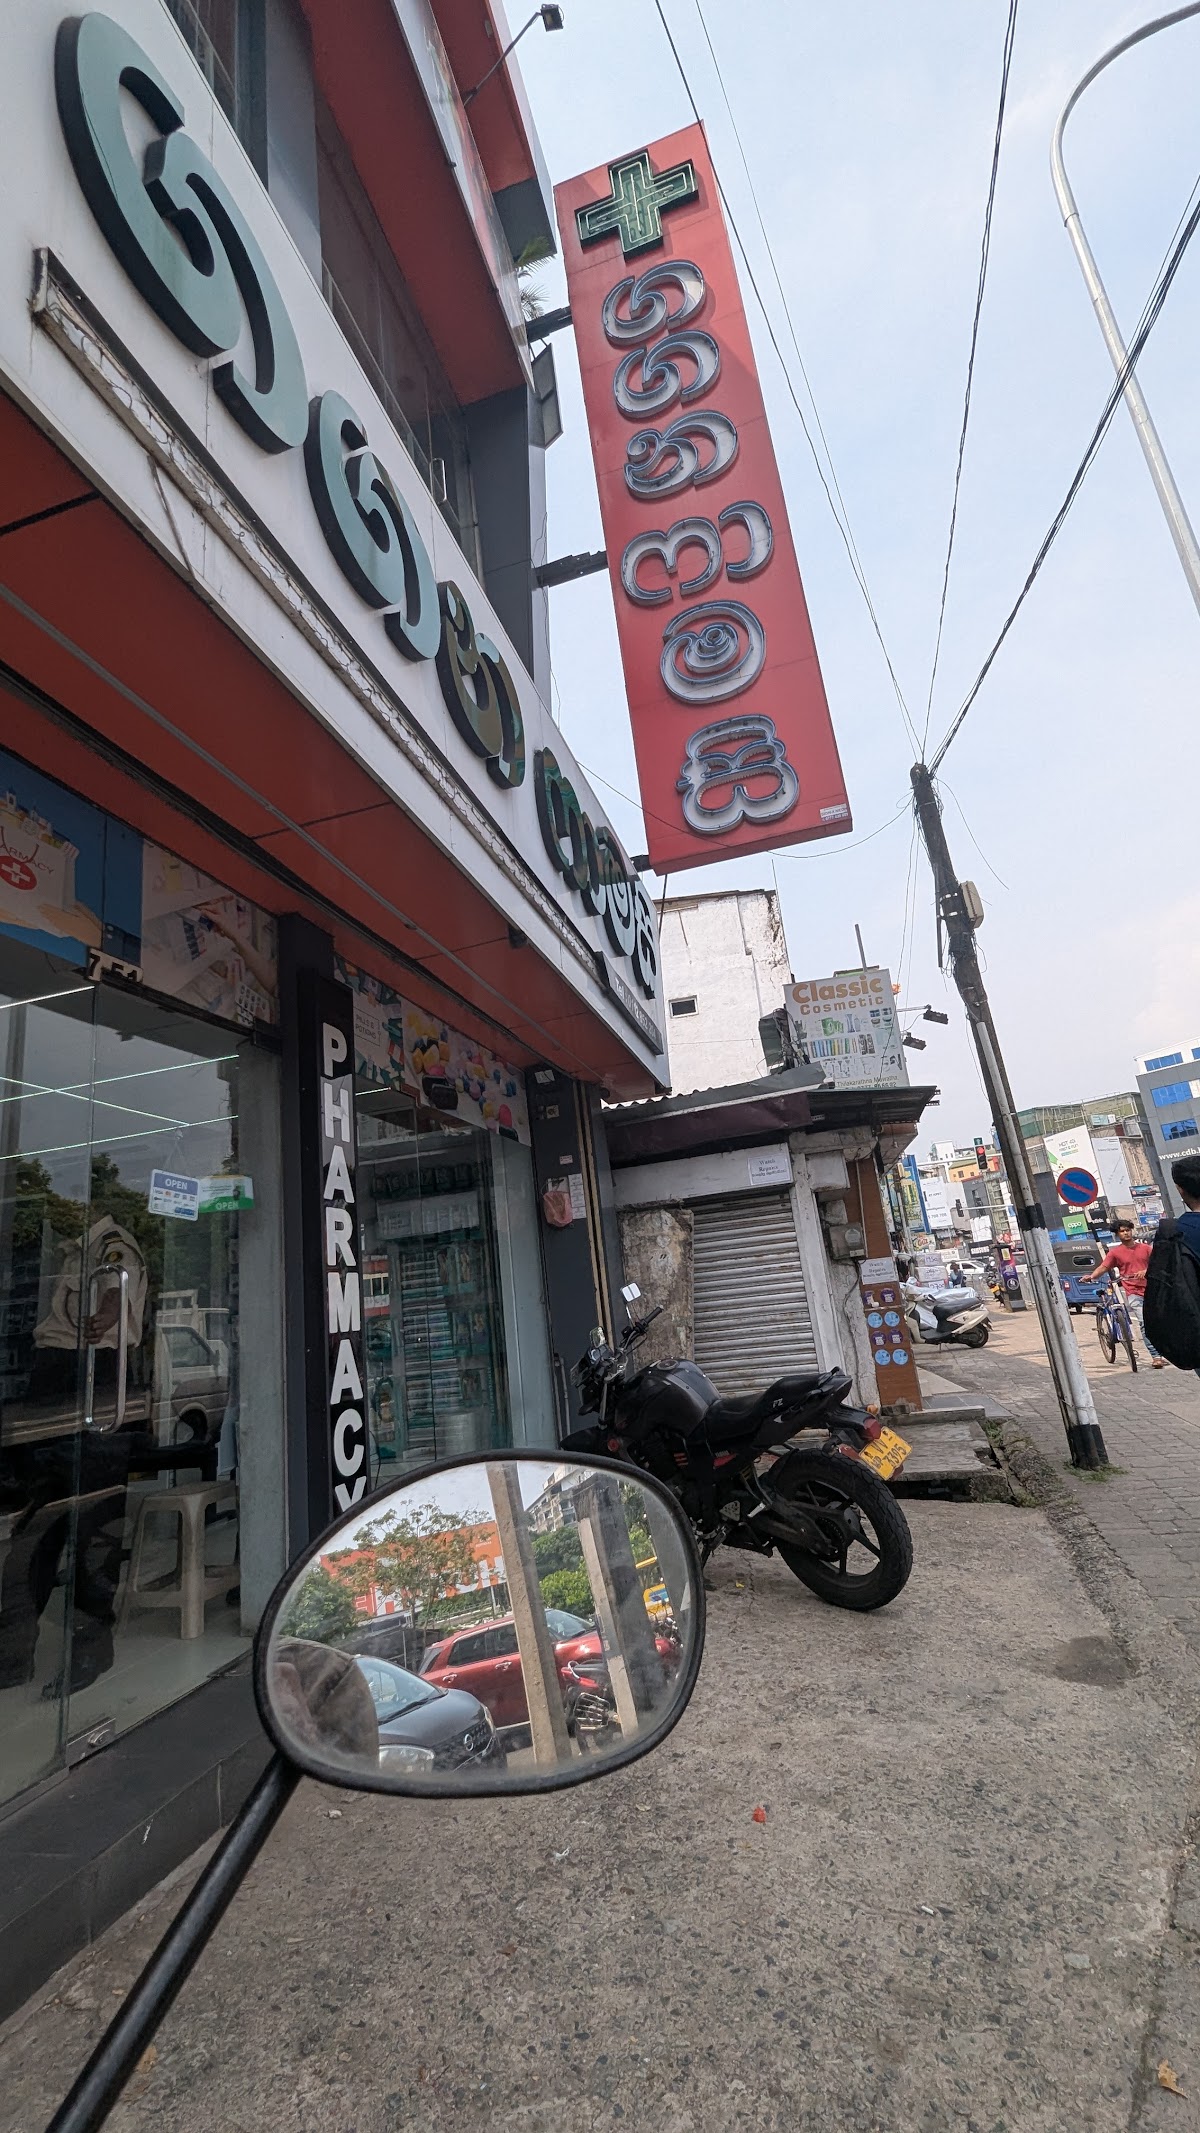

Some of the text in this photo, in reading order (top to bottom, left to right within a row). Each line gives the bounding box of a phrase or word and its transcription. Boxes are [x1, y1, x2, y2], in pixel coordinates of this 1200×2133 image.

[792, 975, 884, 1004] Classic
[800, 995, 884, 1015] Cosmetic
[165, 1178, 188, 1190] OPEN
[215, 1201, 239, 1211] OPEN
